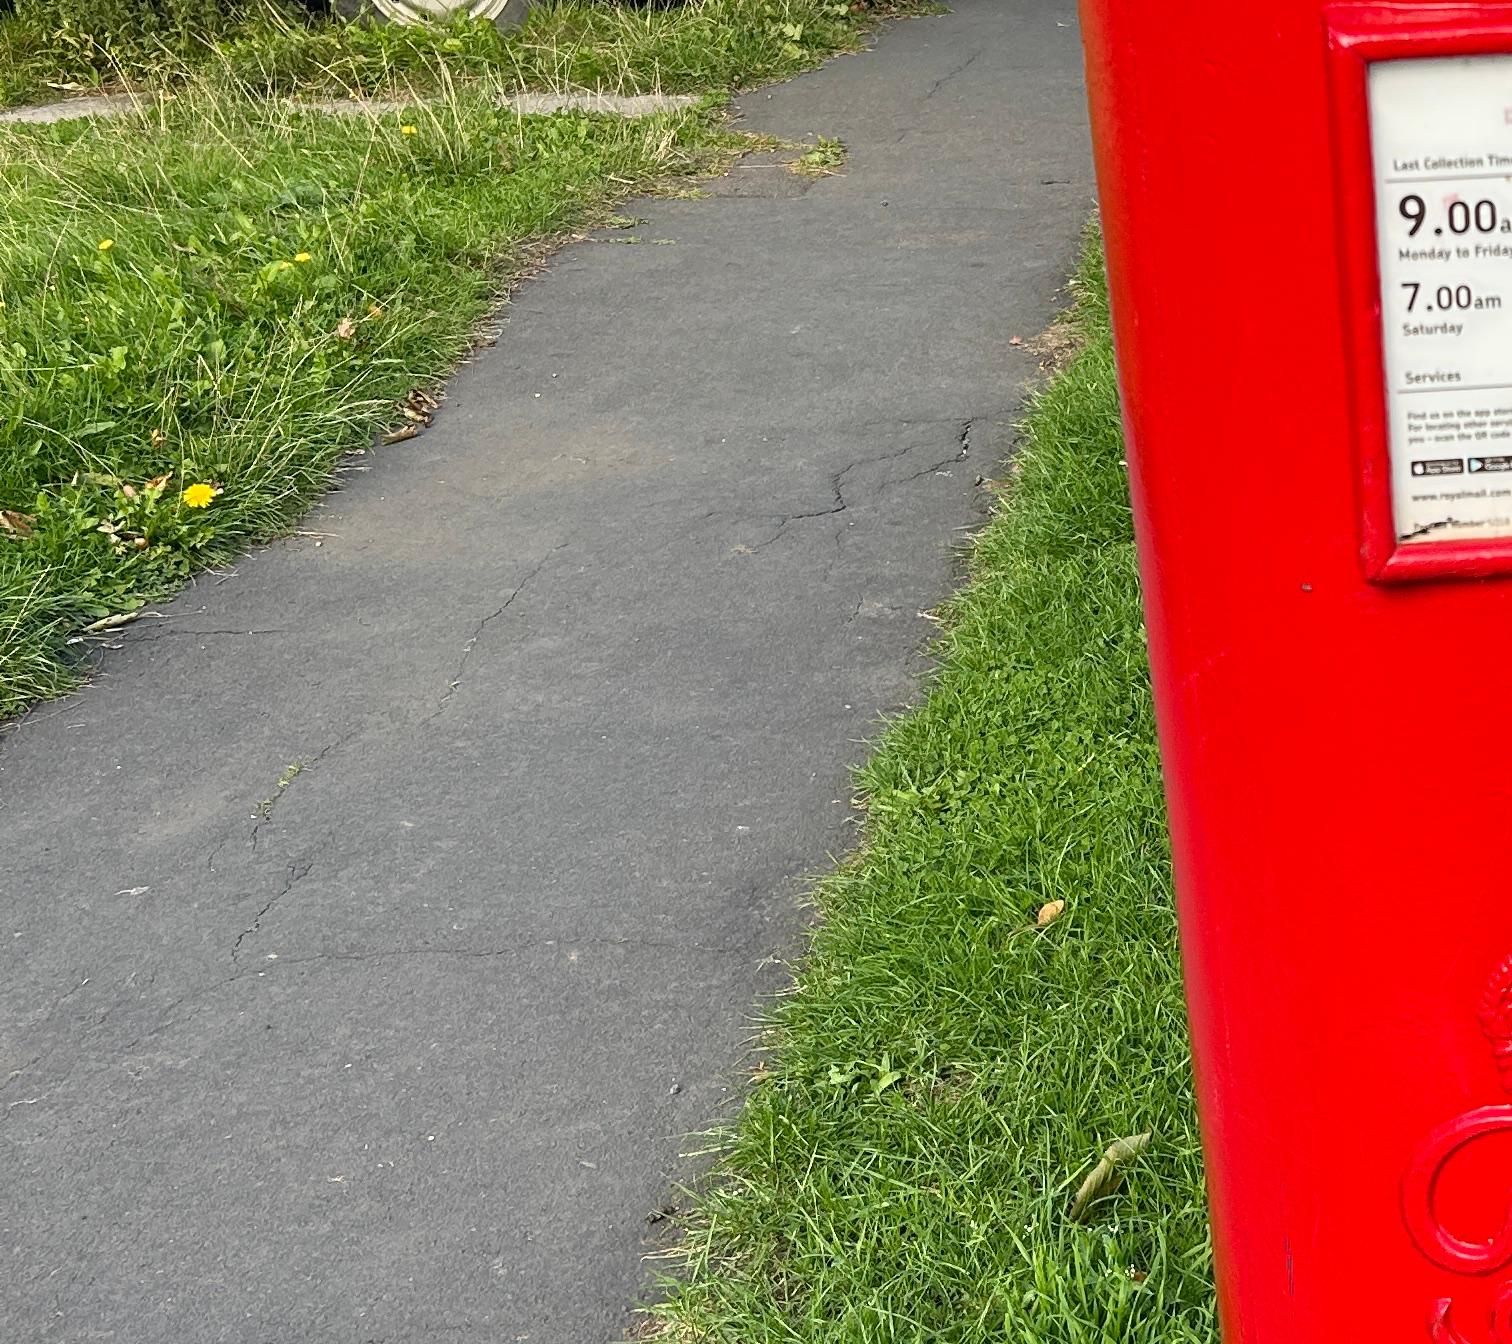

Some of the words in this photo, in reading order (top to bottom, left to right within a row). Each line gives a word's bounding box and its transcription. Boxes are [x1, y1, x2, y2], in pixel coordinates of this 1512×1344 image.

[1393, 157, 1420, 172] Last
[1424, 154, 1484, 170] Collection
[1399, 247, 1451, 262] Monday
[1456, 246, 1470, 258] to
[1403, 322, 1464, 337] Saturday
[1405, 371, 1461, 384] Services
